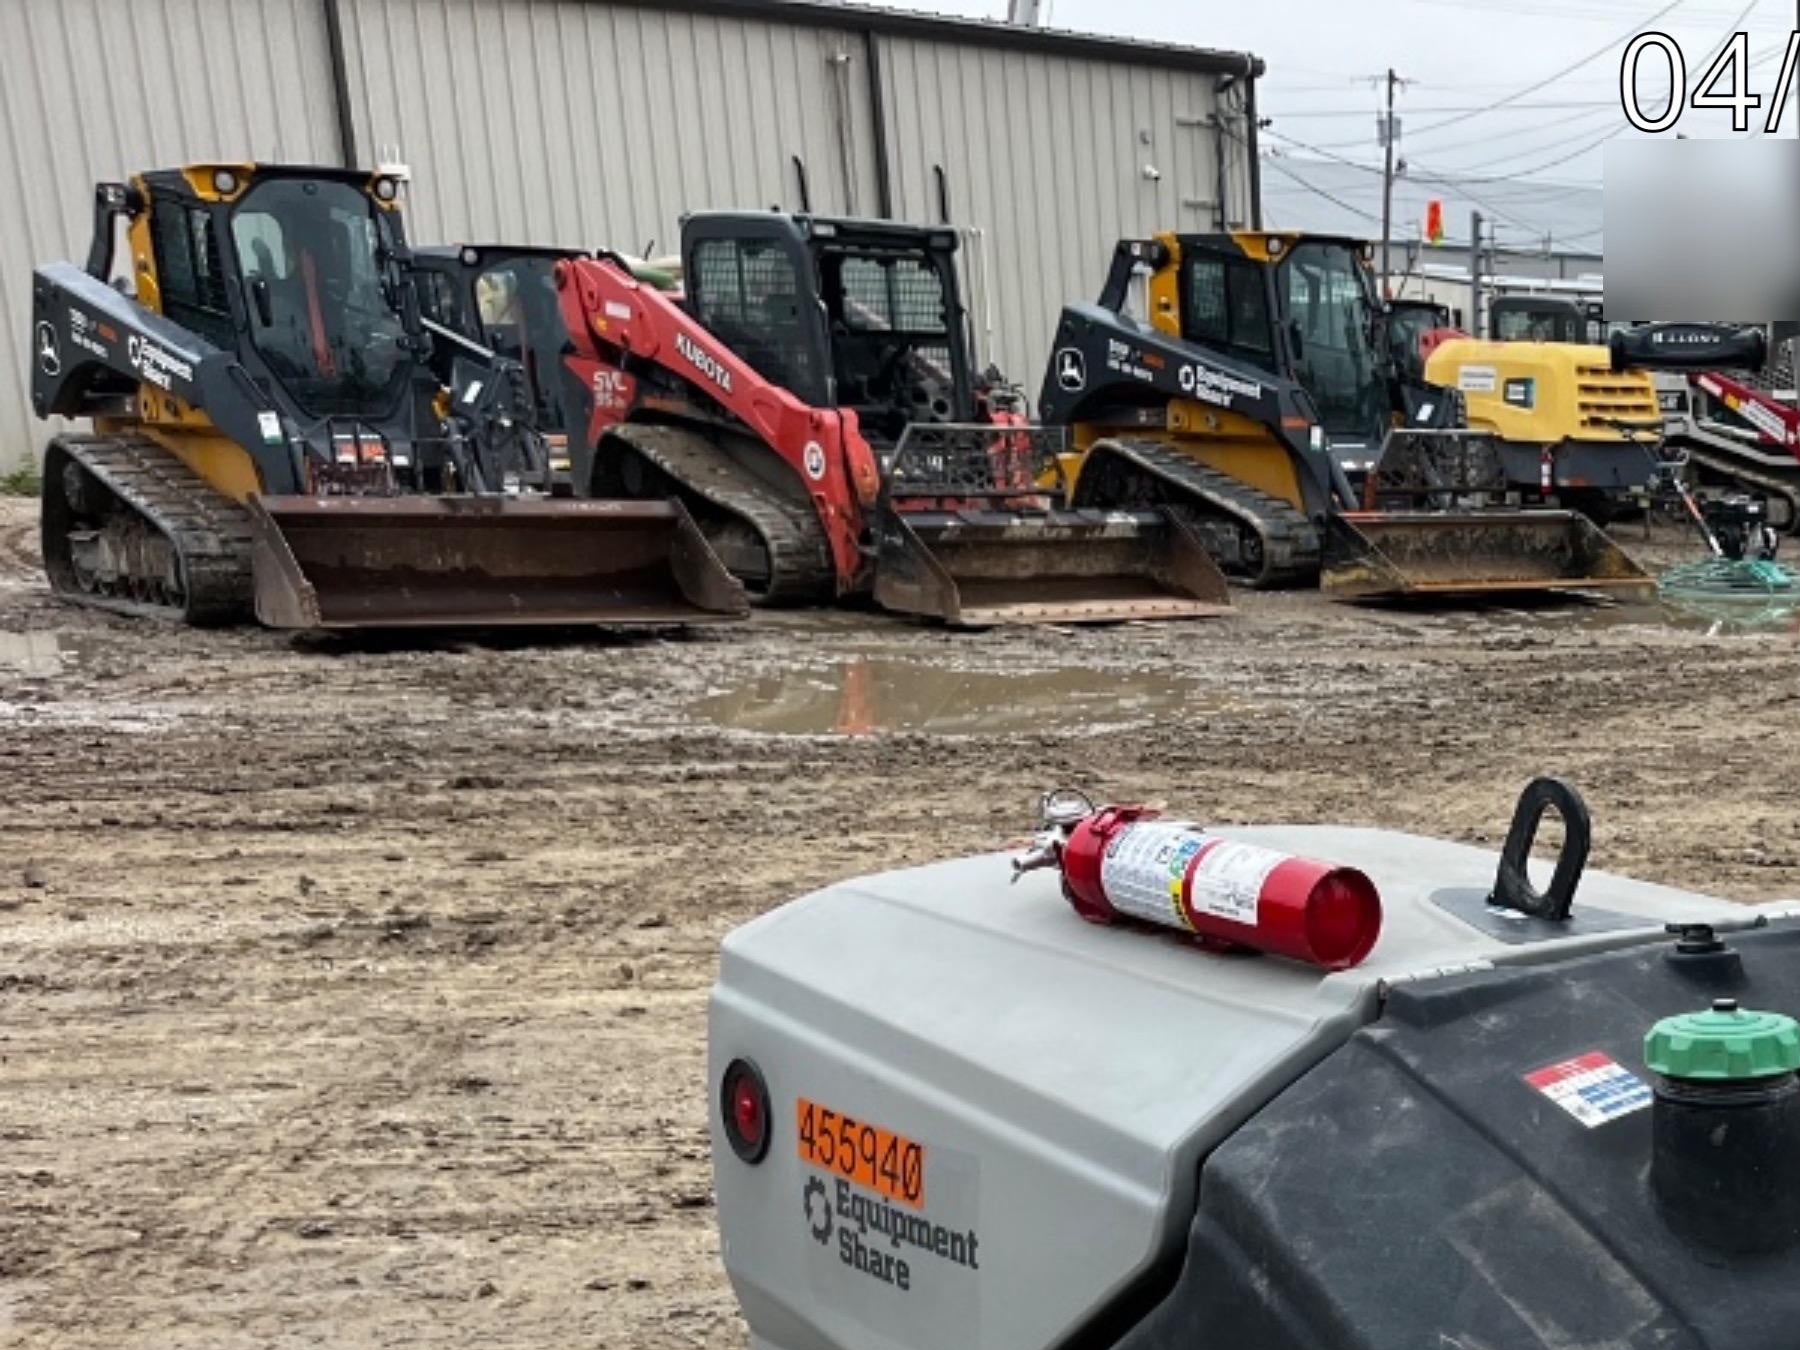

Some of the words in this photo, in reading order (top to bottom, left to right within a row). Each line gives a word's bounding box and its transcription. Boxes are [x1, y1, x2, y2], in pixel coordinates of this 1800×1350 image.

[676, 332, 732, 392] KUBOTA
[800, 1103, 922, 1201] 455940
[835, 1178, 978, 1269] Equipment
[839, 1226, 909, 1290] Share
